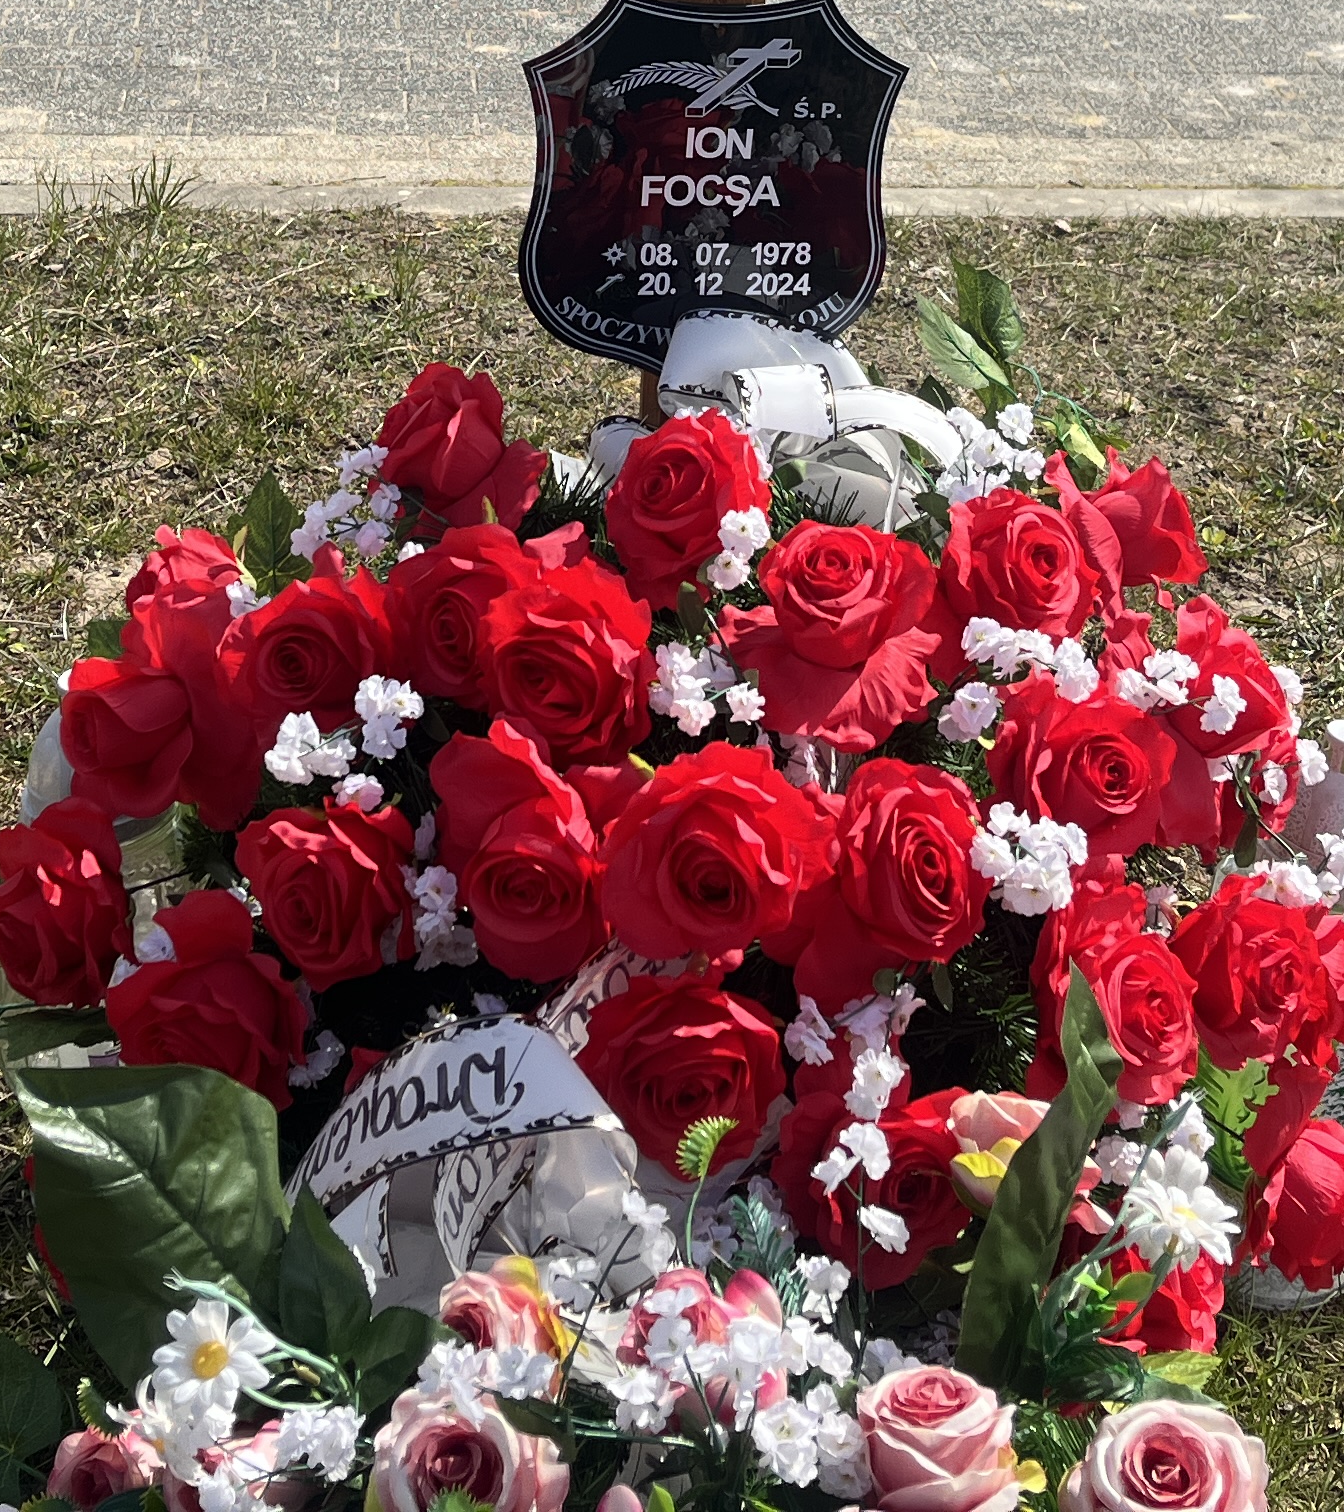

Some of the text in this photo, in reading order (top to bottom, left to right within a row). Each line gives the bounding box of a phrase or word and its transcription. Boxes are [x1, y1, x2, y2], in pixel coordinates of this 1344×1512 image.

[685, 127, 754, 160] ION
[639, 242, 812, 267] 08. 07. 1978
[637, 272, 811, 296] 20. 12 2024
[554, 290, 845, 347] SPOCZYW OJU
